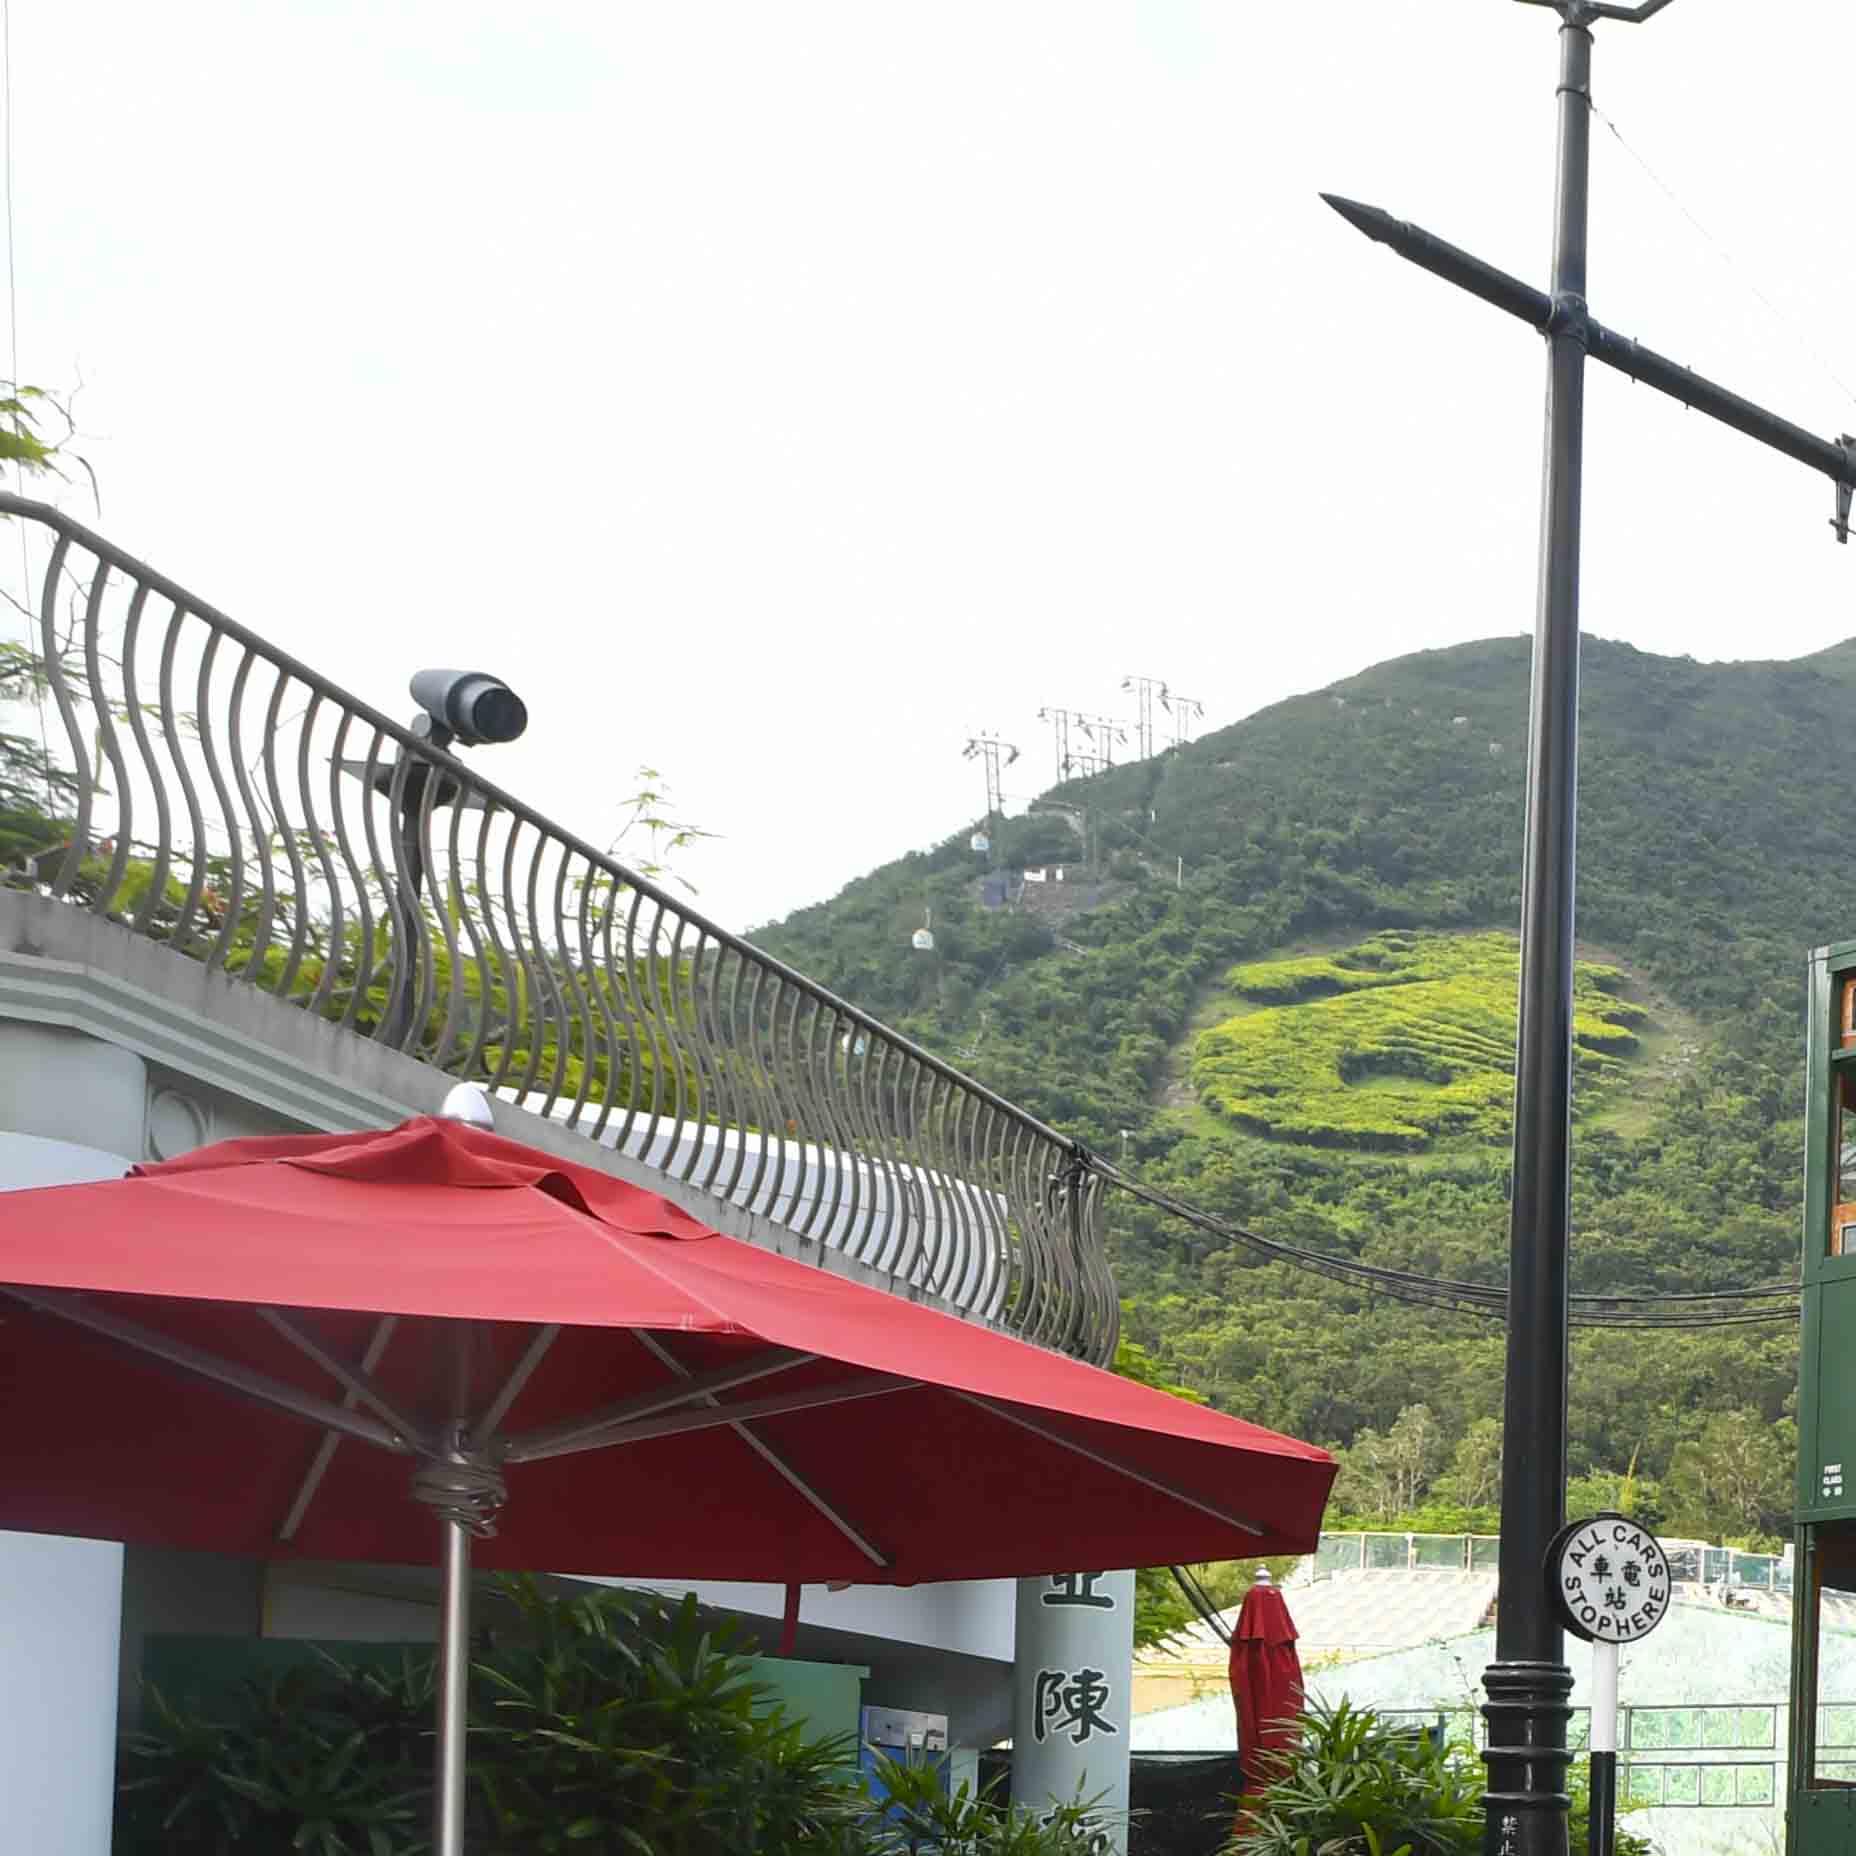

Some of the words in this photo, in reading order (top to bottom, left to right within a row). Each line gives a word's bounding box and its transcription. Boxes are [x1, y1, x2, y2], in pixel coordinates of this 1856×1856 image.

[1568, 1528, 1607, 1569] ALL
[1612, 1525, 1664, 1579] CARS
[1565, 1575, 1612, 1632] STOP
[1616, 1585, 1665, 1636] HERE
